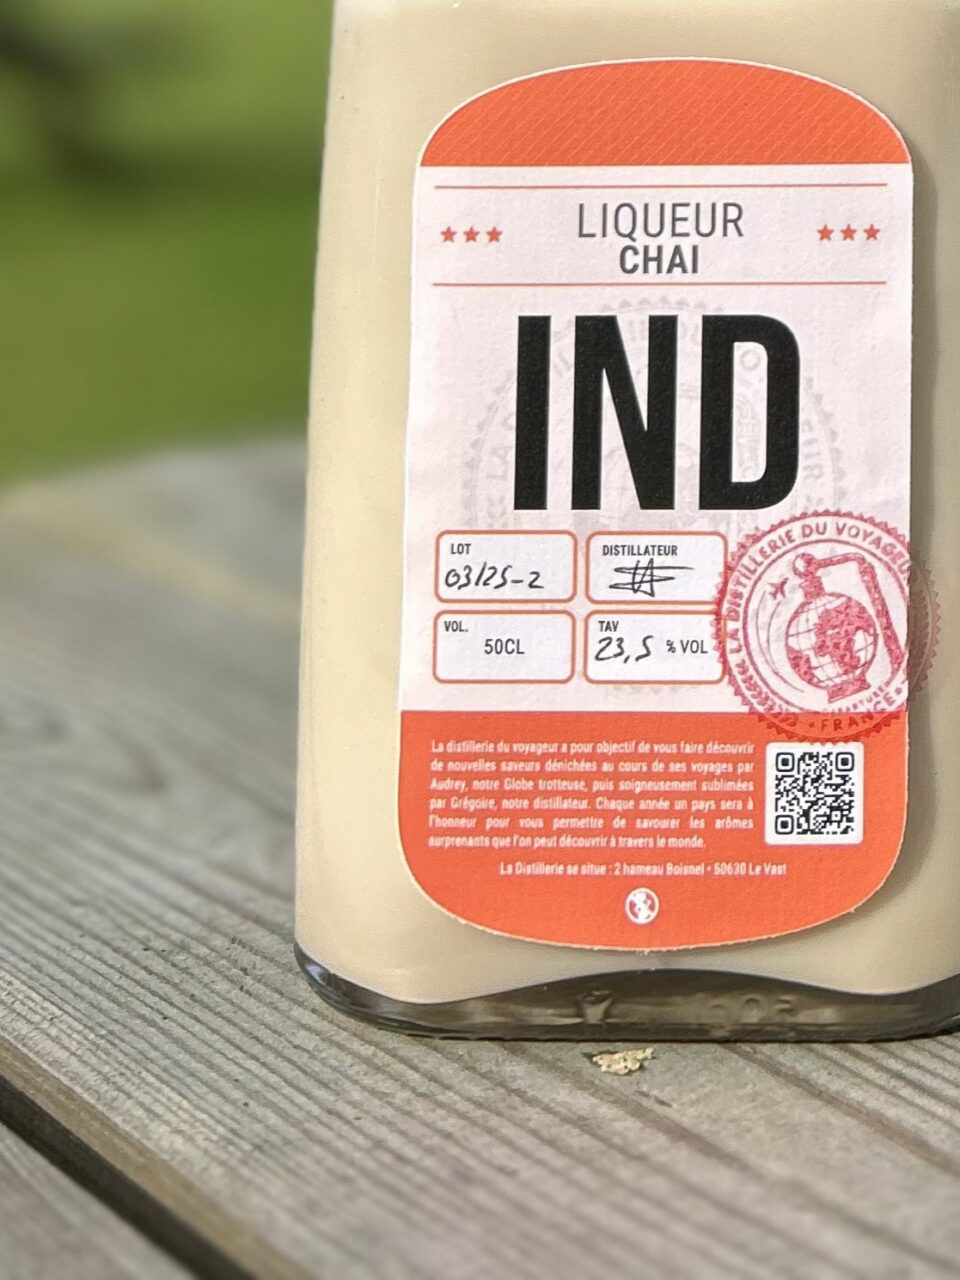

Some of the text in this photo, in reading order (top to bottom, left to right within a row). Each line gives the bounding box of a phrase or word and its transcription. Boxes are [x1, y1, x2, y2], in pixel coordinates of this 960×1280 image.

[578, 201, 744, 243] LIQUEUR
[618, 244, 699, 275] CHAI
[513, 313, 801, 510] IND
[801, 521, 827, 538] DU
[450, 543, 472, 555] LOT
[602, 544, 678, 556] DISTILLATEUR
[444, 561, 545, 590] 03/25-2
[727, 529, 797, 621] DISTILLERIE
[444, 620, 469, 632] VOL.
[598, 620, 619, 632] TAV
[484, 638, 525, 655] 50CL
[728, 627, 743, 655] LA
[594, 635, 708, 664] 23,5 % VOL
[431, 740, 444, 753] La
[446, 740, 495, 753] distillerie
[497, 740, 510, 753] du
[513, 743, 558, 755] voyageur
[570, 743, 593, 755] pour
[596, 741, 636, 756] objectif
[638, 741, 650, 754] de
[653, 743, 677, 754] vous
[680, 741, 704, 754] faire
[706, 741, 755, 754] découvrir
[430, 758, 755, 775] de nouvelles saveurs dénichées au cours de ses voyages par
[430, 777, 468, 793] Audrey,
[472, 779, 499, 791] notre
[504, 777, 534, 791] Globe
[592, 780, 614, 793] puis
[429, 796, 754, 812] par Grégoire, notre distillateur. Chaque année un pays sera à
[485, 818, 510, 831] pour
[519, 818, 544, 828] vous
[553, 817, 605, 831] permettre
[612, 816, 626, 829] de
[689, 816, 705, 829] les
[492, 837, 511, 850] que
[533, 836, 557, 850] peut
[559, 835, 607, 848] découvrir
[610, 835, 616, 848] à
[618, 836, 653, 848] travers
[656, 835, 666, 848] le
[668, 835, 706, 848] monde.
[500, 862, 513, 875] La
[515, 862, 565, 875] Distillerie
[566, 864, 579, 875] se
[614, 862, 621, 875] 2
[623, 862, 663, 876] hameau
[713, 862, 747, 876] 50630
[748, 862, 761, 876] Le
[763, 862, 787, 876] Vast
